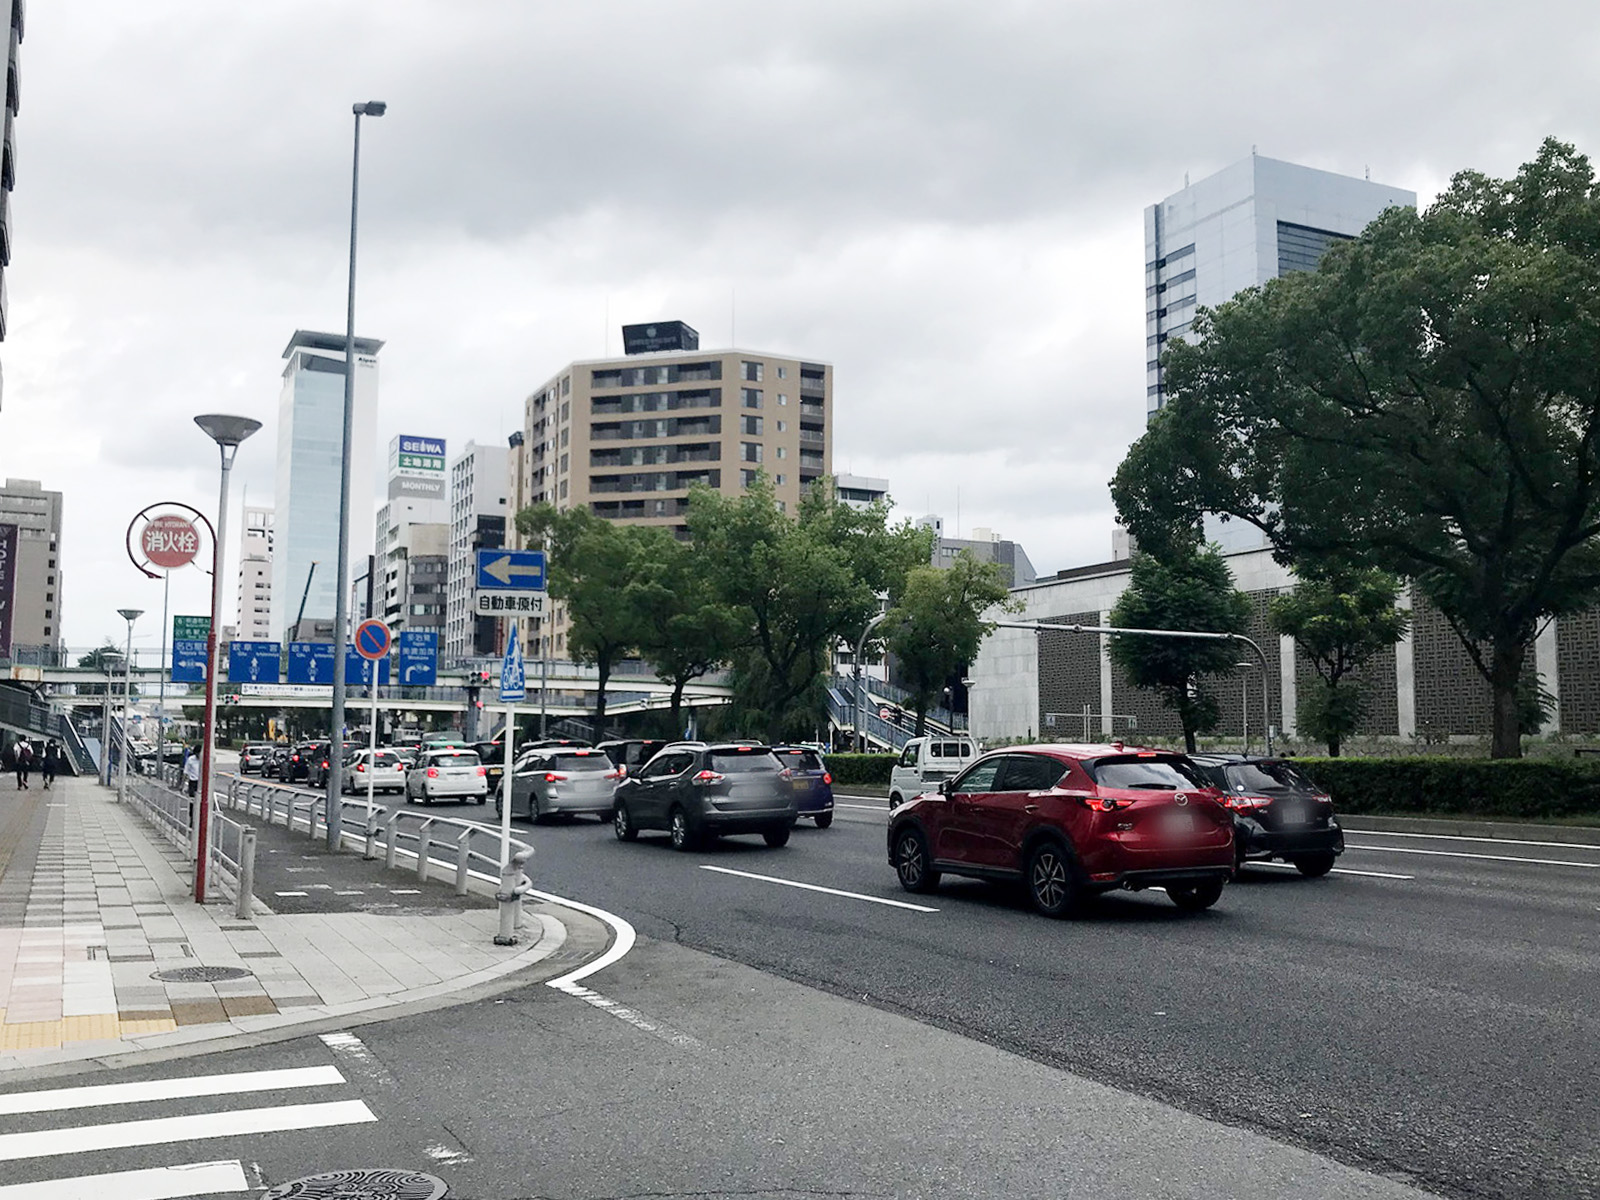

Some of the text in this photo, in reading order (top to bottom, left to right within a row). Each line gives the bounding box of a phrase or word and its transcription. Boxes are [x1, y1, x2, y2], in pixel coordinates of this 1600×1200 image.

[402, 481, 441, 491] MONTHLY
[146, 530, 197, 553] 消火栓
